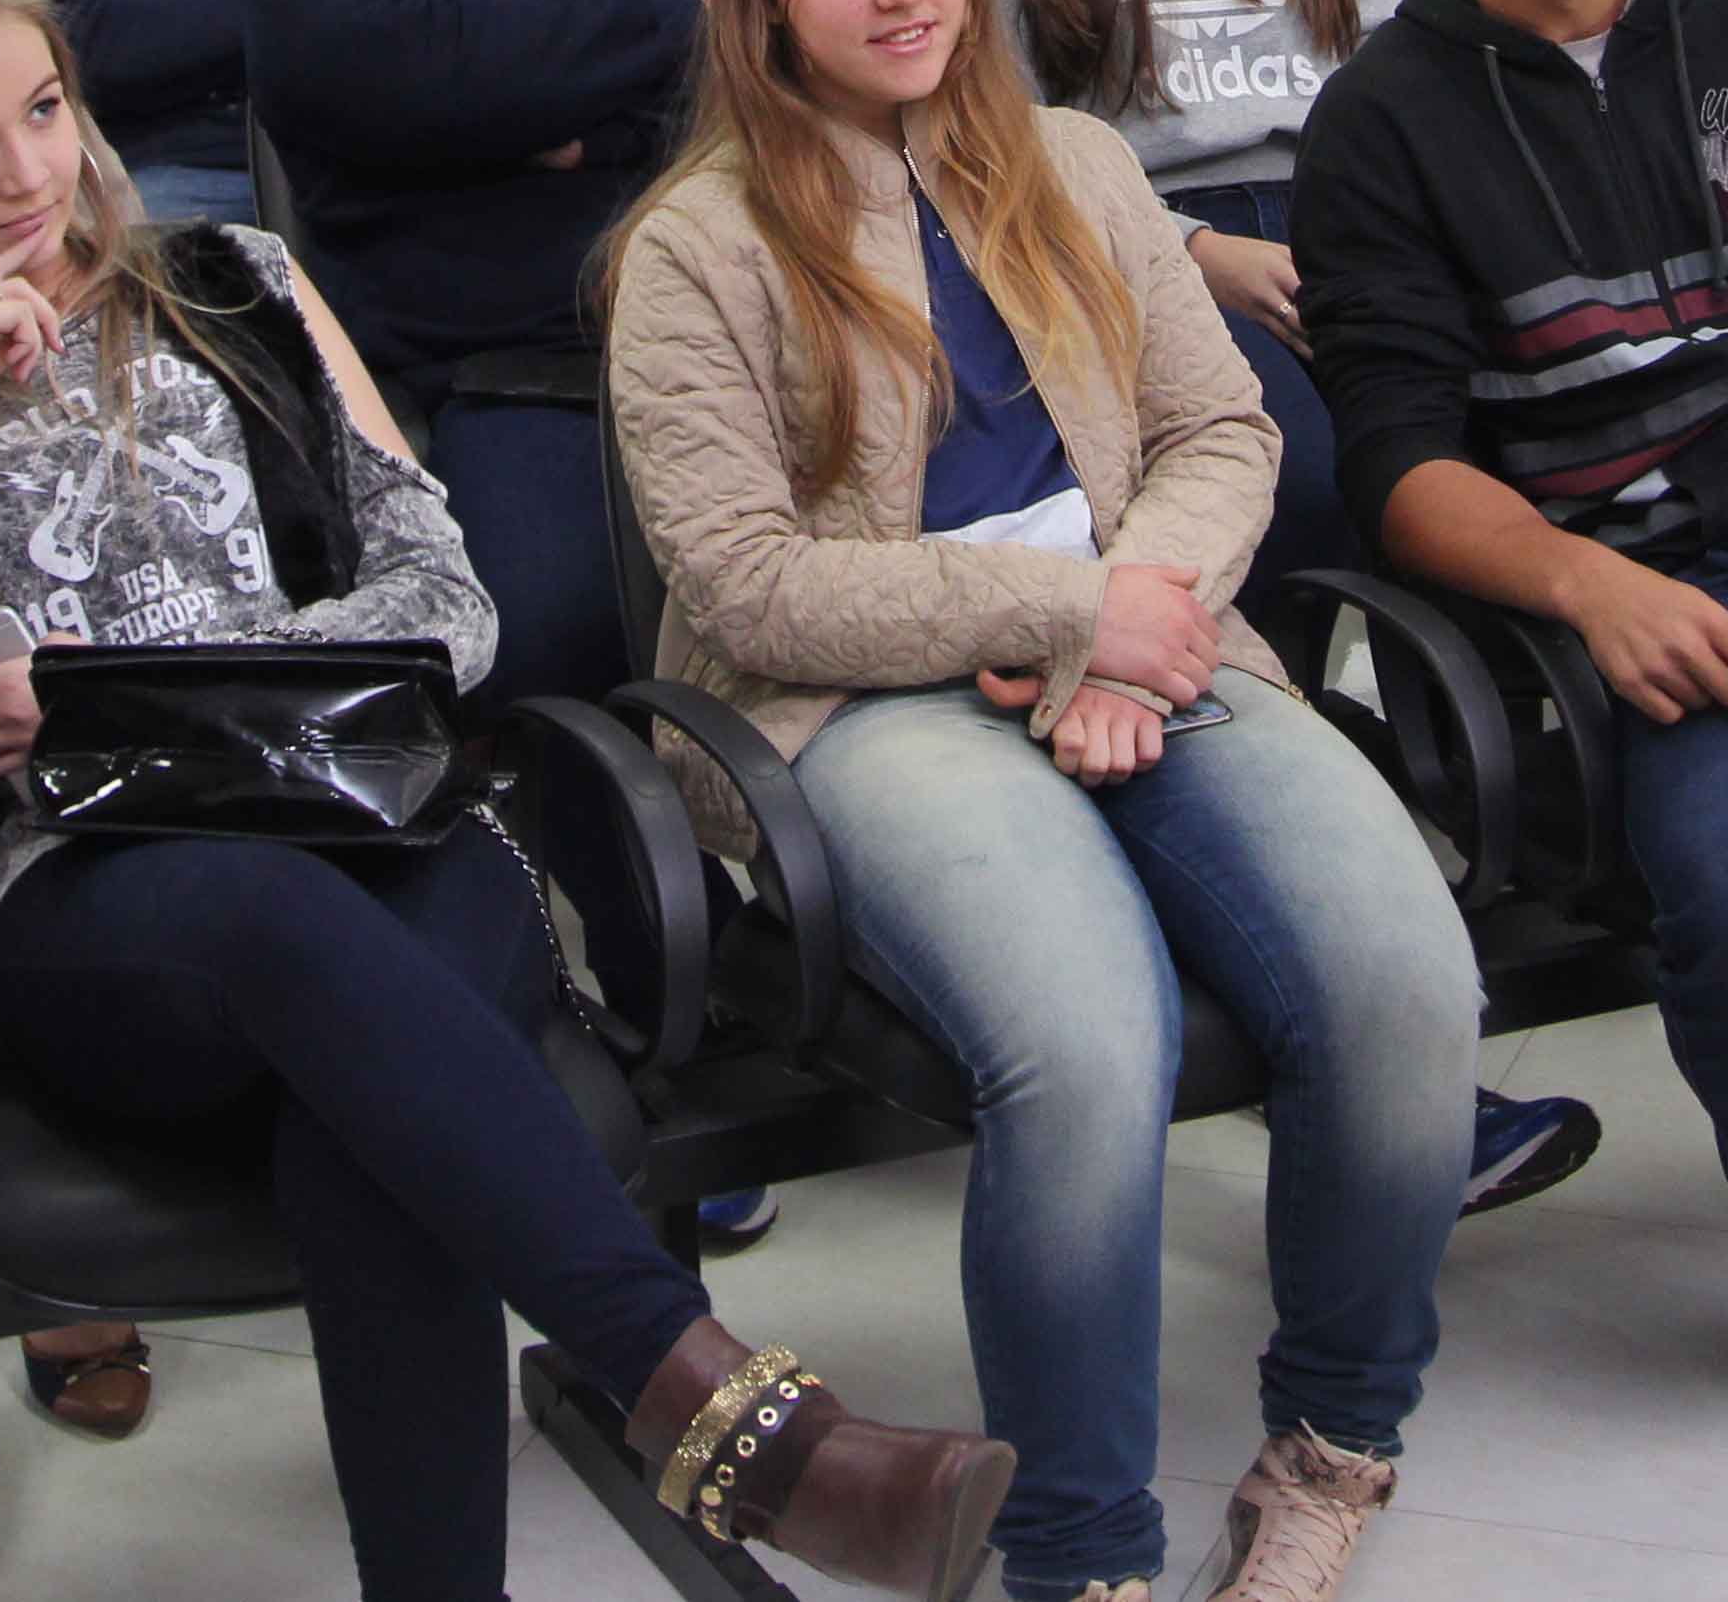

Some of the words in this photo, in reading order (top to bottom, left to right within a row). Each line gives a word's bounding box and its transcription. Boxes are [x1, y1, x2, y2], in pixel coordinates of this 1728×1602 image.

[1167, 44, 1322, 103] didas
[119, 557, 185, 605] USA
[106, 587, 220, 646] EUROPE
